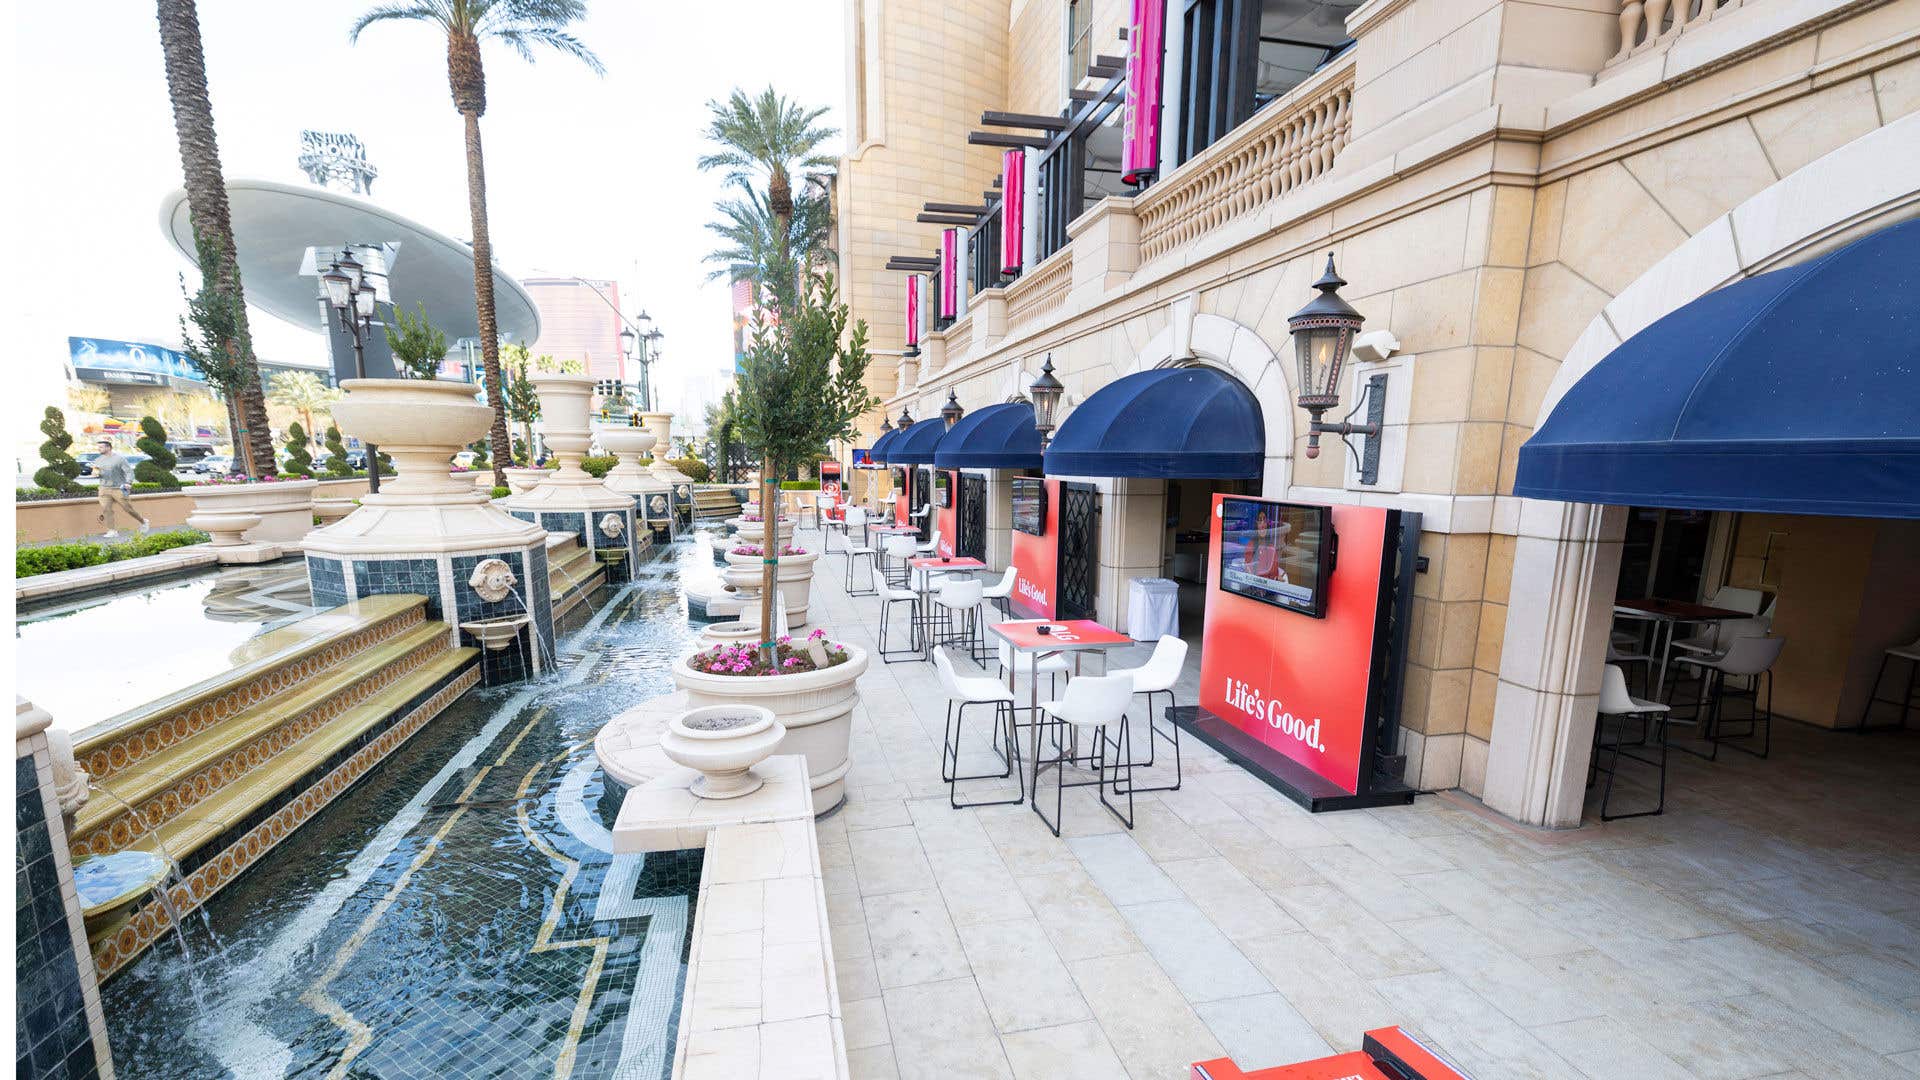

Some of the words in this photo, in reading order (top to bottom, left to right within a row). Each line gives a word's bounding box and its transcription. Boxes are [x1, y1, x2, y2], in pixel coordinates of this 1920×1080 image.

[300, 129, 358, 149] FASHION
[301, 141, 364, 159] SHOW
[1031, 584, 1048, 606] Good.
[1224, 677, 1265, 720] Life's
[1267, 699, 1326, 753] Good.
